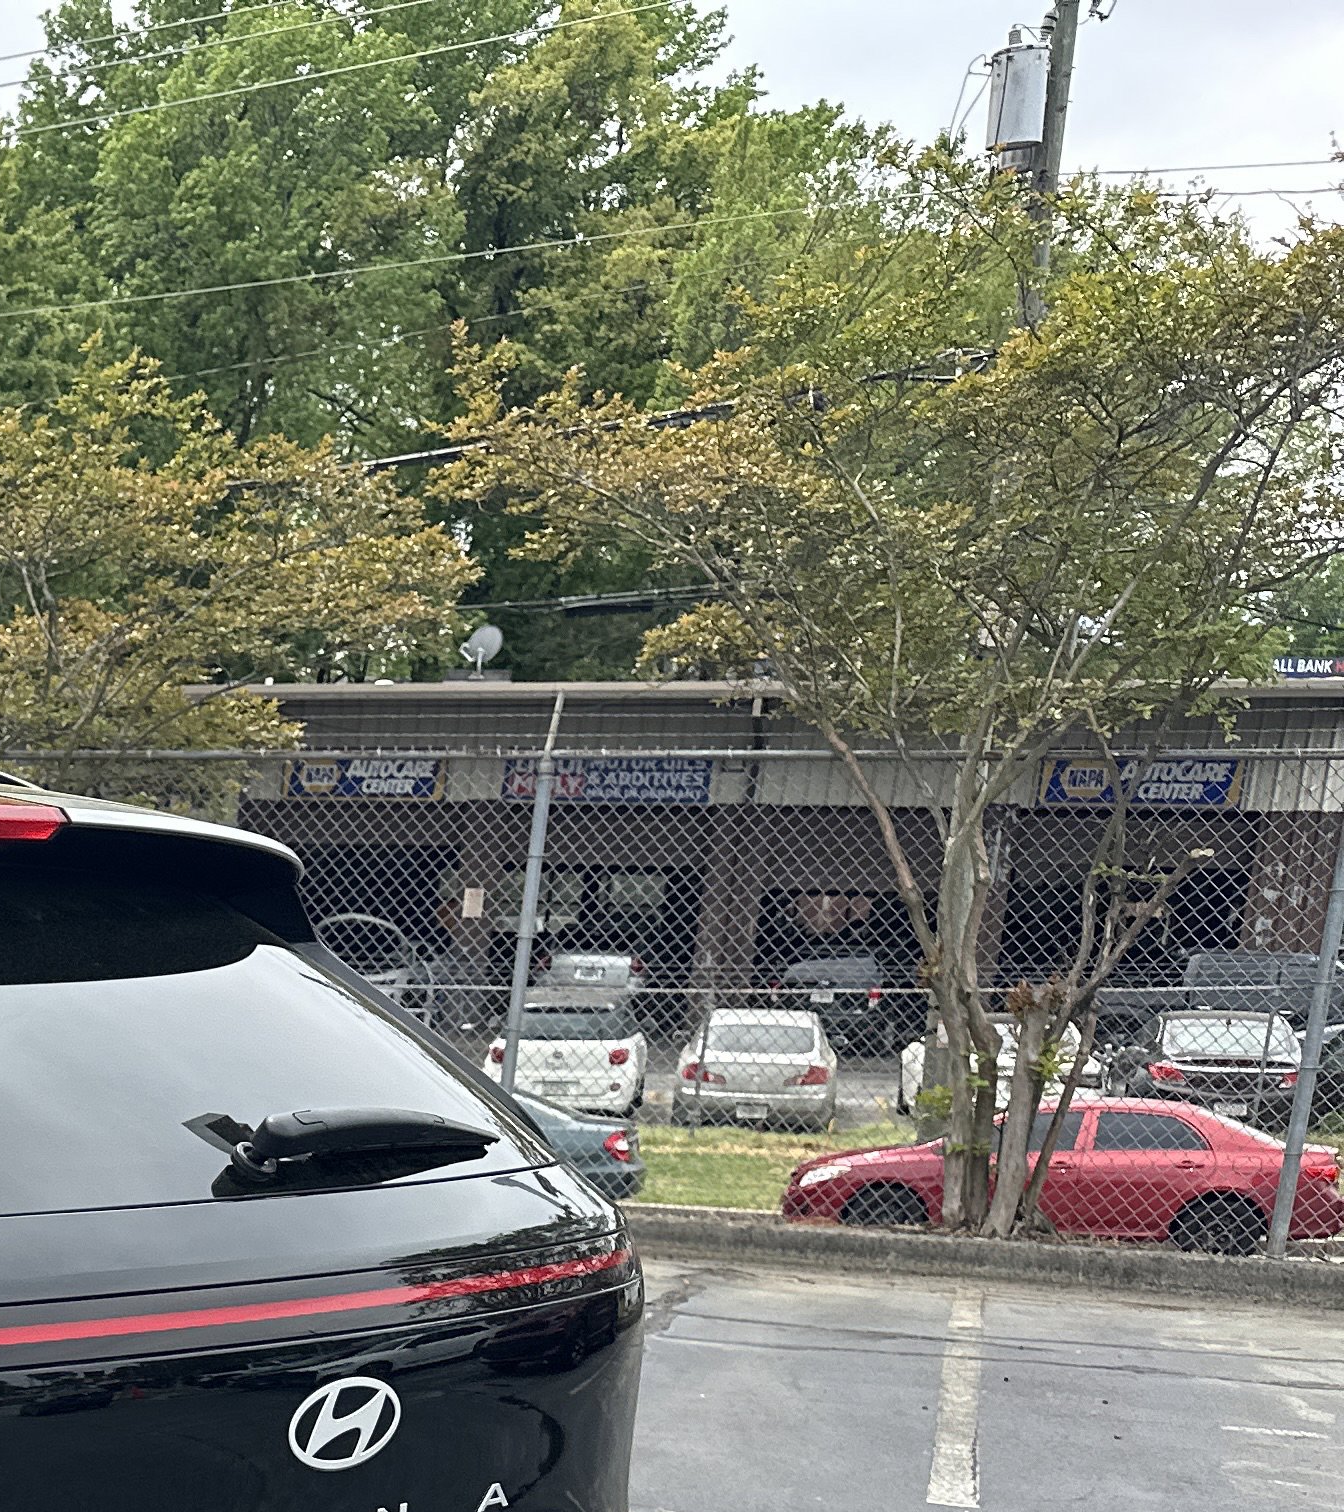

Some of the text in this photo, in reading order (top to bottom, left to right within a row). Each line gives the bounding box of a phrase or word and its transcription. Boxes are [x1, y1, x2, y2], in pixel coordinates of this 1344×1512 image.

[1297, 659, 1333, 673] BANK
[361, 778, 415, 794] CENTER
[1067, 768, 1105, 788] NAPA
[1137, 783, 1203, 799] CENTER
